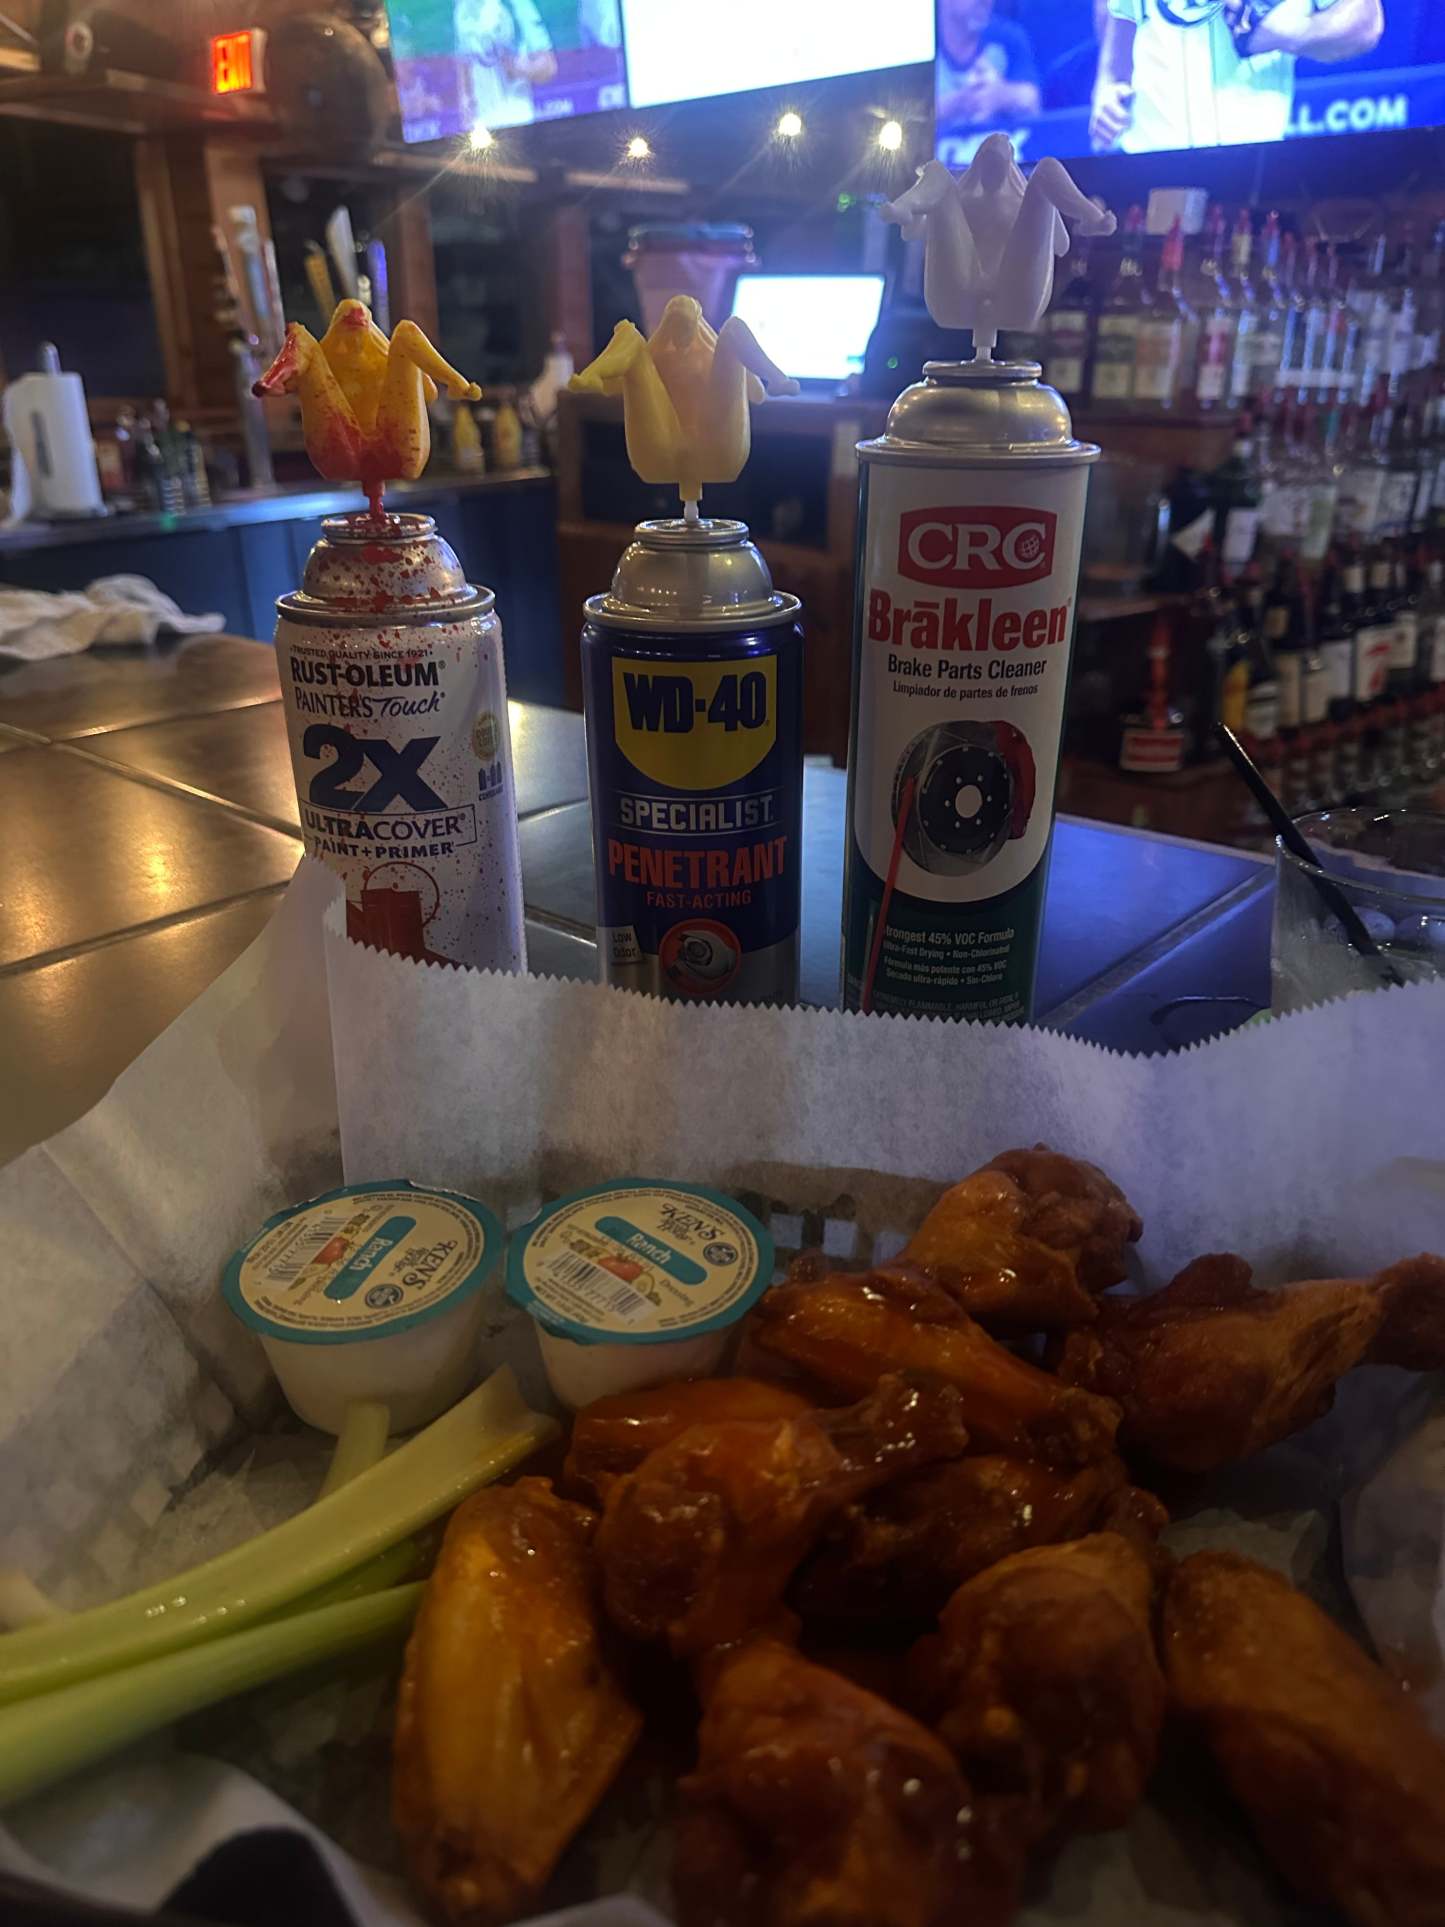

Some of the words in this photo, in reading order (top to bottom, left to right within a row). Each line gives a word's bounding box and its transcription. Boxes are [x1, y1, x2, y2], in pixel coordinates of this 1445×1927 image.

[909, 522, 1046, 570] CRC
[328, 650, 369, 660] QUALITY
[373, 651, 404, 660] SINCE
[888, 653, 932, 677] Brake
[938, 660, 982, 679] Parts
[988, 660, 1047, 679] Cleaner
[291, 657, 439, 687] RUST-OLEUM
[372, 691, 440, 717] Touch
[623, 671, 766, 733] WD-40
[893, 680, 941, 698] Limpiador
[944, 687, 957, 698] de
[959, 688, 993, 700] partes
[996, 686, 1008, 698] de
[1010, 683, 1038, 696] frenos
[303, 723, 448, 812] 2X
[621, 794, 772, 831] SPECIALIST
[608, 834, 788, 889] PENETRANT
[645, 889, 752, 909] FAST-ACTING
[886, 925, 926, 944] trongest
[927, 932, 952, 945] 45%
[954, 932, 976, 945] VOC
[978, 927, 1015, 944] Formula
[919, 948, 945, 960] Drying
[348, 1236, 395, 1272] Ranch
[626, 1231, 673, 1265] Ranch
